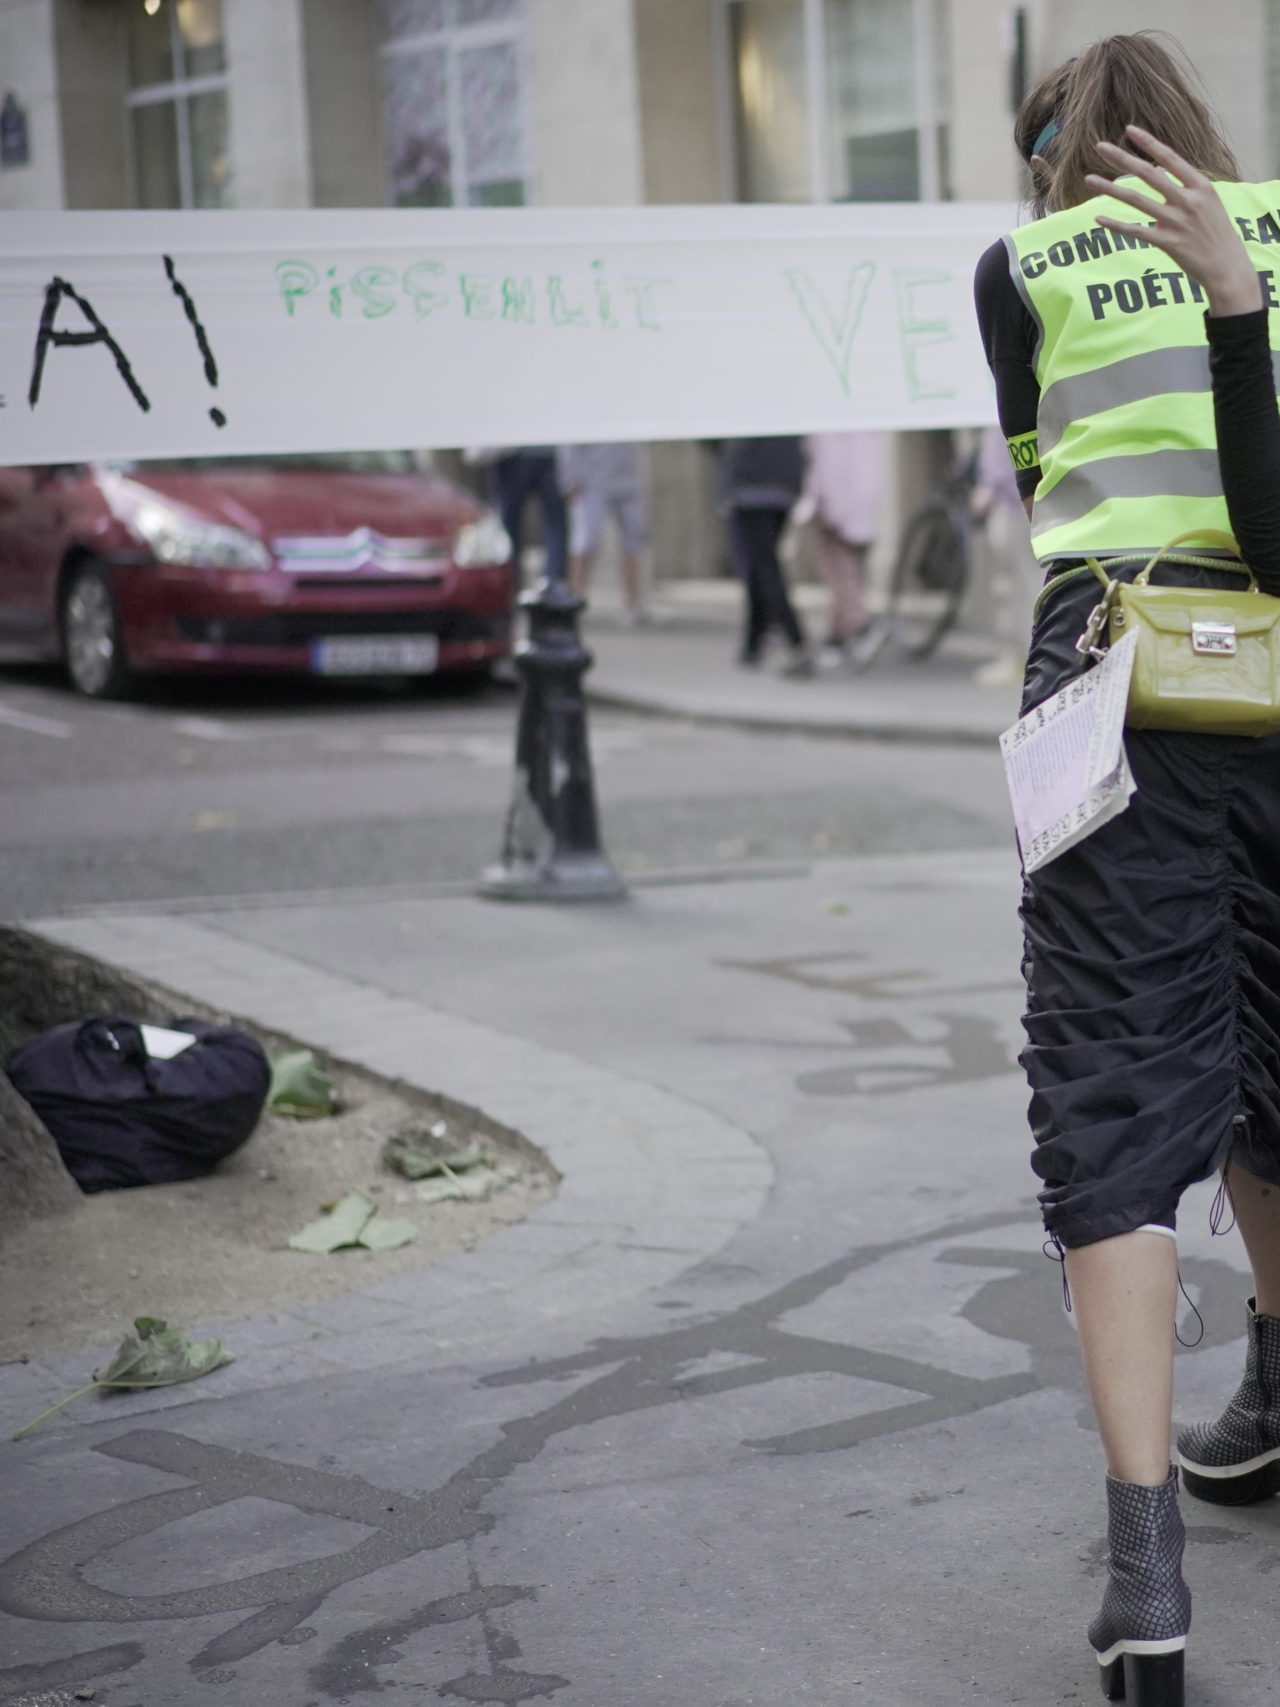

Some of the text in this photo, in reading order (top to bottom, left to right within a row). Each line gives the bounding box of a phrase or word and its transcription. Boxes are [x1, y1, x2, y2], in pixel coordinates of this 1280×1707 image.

[0, 253, 227, 429] A!
[782, 259, 962, 404] VE
[1085, 268, 1280, 322] POÉTIE
